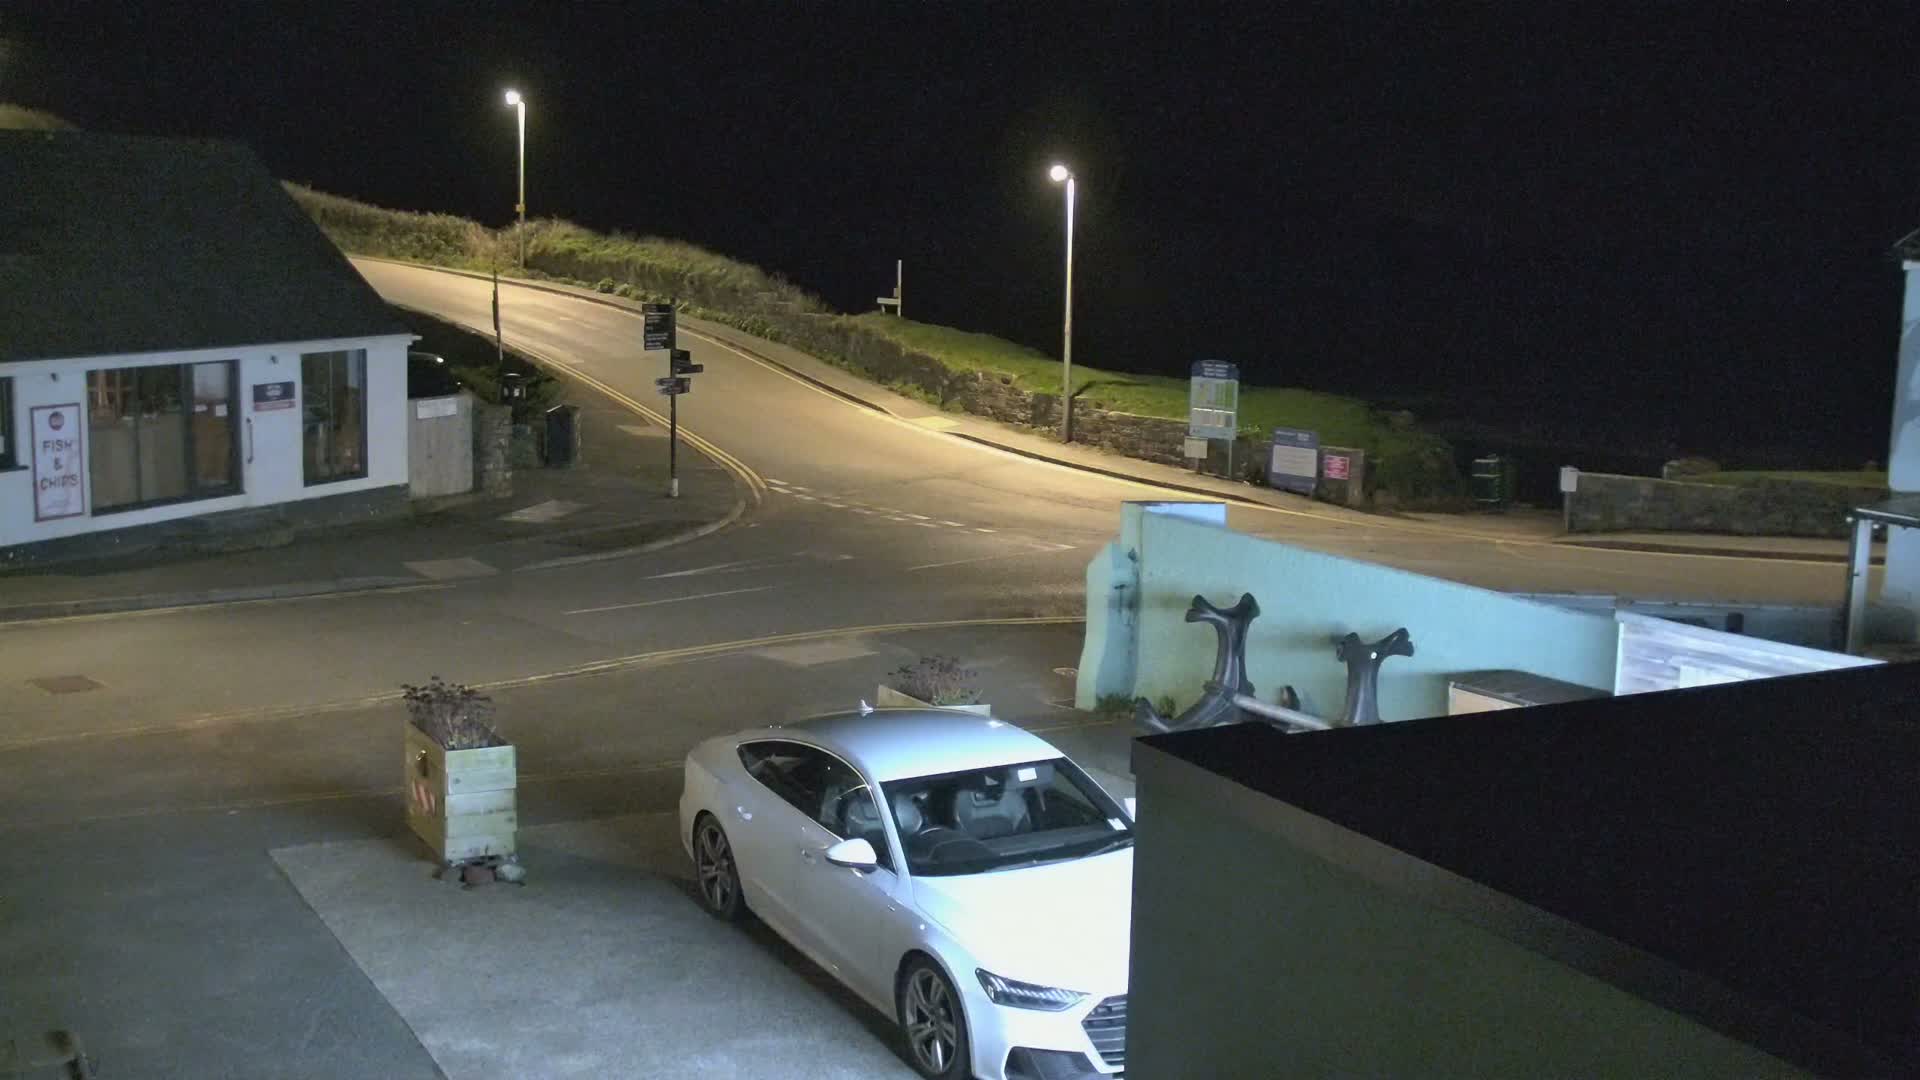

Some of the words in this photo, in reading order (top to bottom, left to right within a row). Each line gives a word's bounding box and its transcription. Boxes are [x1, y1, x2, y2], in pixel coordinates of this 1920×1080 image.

[42, 439, 72, 452] FISH
[54, 457, 63, 471] &
[40, 474, 79, 490] CHIPS
